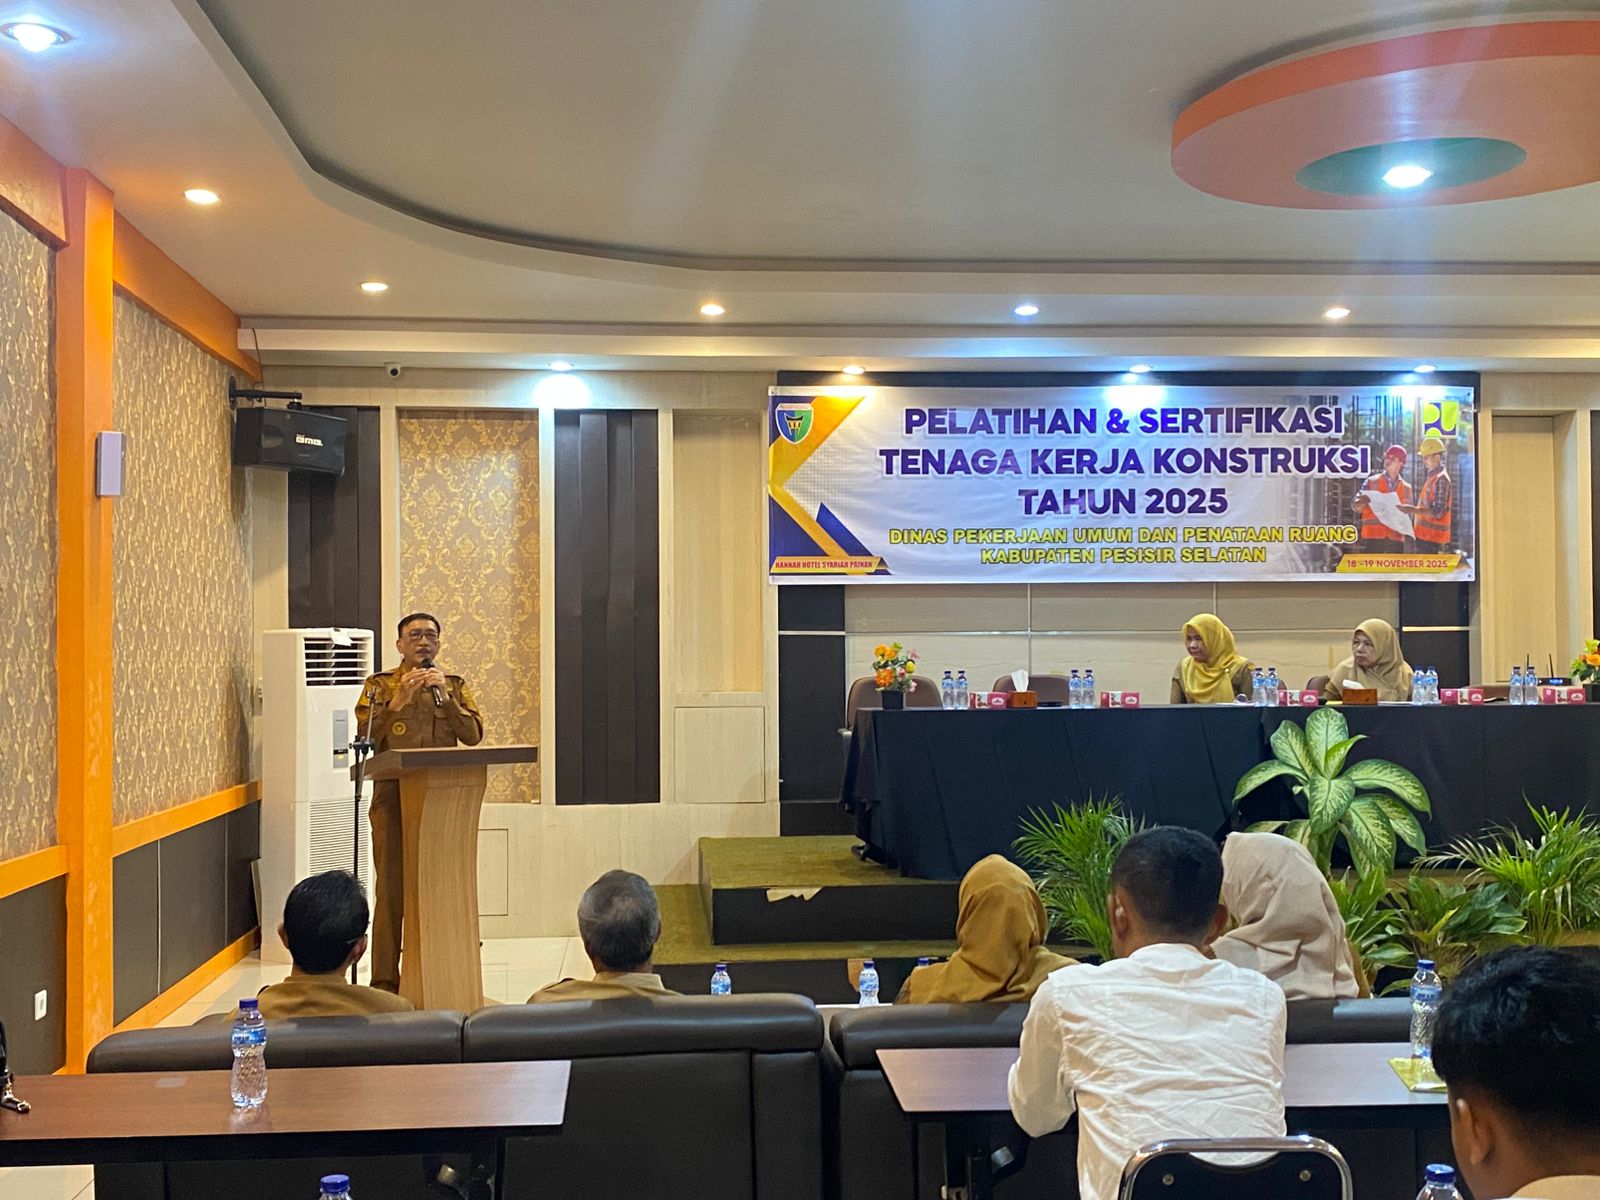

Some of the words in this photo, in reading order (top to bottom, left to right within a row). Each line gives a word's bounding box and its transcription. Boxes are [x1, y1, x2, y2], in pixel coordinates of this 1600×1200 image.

[904, 408, 1097, 435] PELATIHAN
[1106, 408, 1130, 434] &
[1139, 407, 1343, 434] SERTIFIKASI
[879, 448, 1021, 475] TENAGA
[1030, 448, 1145, 475] KERJA
[1153, 447, 1370, 474] KONSTRUKSI
[1018, 488, 1135, 515] TAHUN
[1145, 487, 1229, 514] 2025
[889, 528, 948, 544] DINAS
[953, 528, 1068, 544] PEKERJAAN
[1073, 528, 1132, 544] UMUM
[1138, 527, 1178, 543] DAN
[1183, 527, 1284, 543] PENATAAN
[1289, 526, 1358, 543] RUANG
[980, 548, 1093, 564] KABUPATEN
[1100, 548, 1176, 563] PESISIR
[1181, 547, 1267, 563] SELATAN
[1347, 559, 1357, 568] 18
[1376, 559, 1424, 568] NOVEMBER
[1426, 559, 1448, 568] 2025
[775, 561, 800, 569] HANNAH
[802, 561, 820, 569] HOTEL
